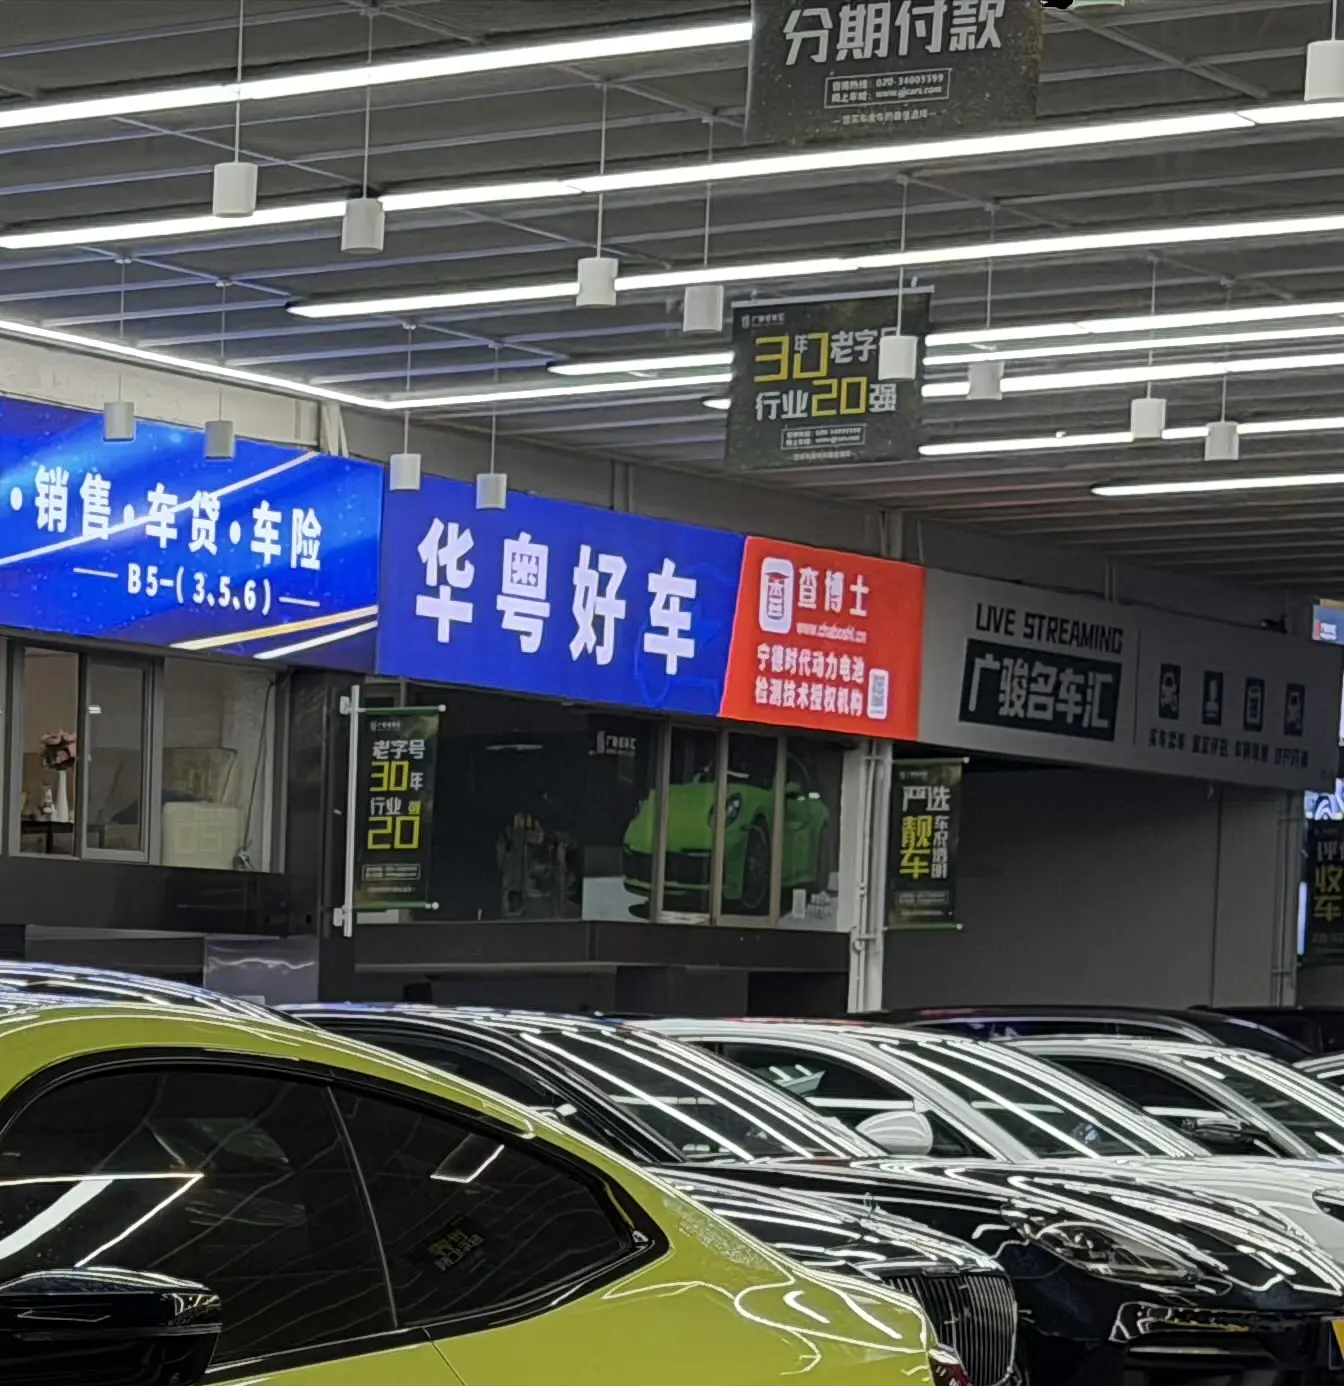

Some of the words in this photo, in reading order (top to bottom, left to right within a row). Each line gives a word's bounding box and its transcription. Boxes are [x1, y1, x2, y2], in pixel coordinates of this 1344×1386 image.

[783, 0, 1006, 65] 分期付款
[416, 518, 697, 675] 华粤好车
[798, 567, 870, 617] 查博士
[976, 603, 1016, 637] LIVE
[1023, 612, 1124, 655] STREAMING
[757, 643, 865, 684] 宁德时代动力电池
[755, 676, 863, 716] 检测技术授权机构
[969, 653, 1113, 729] 广骏名车汇
[372, 739, 426, 760] 老字号
[369, 760, 424, 792] 30年
[902, 785, 951, 812] 严选
[367, 816, 421, 850] 20
[899, 815, 933, 879] 靓车
[1317, 841, 1344, 861] 评
